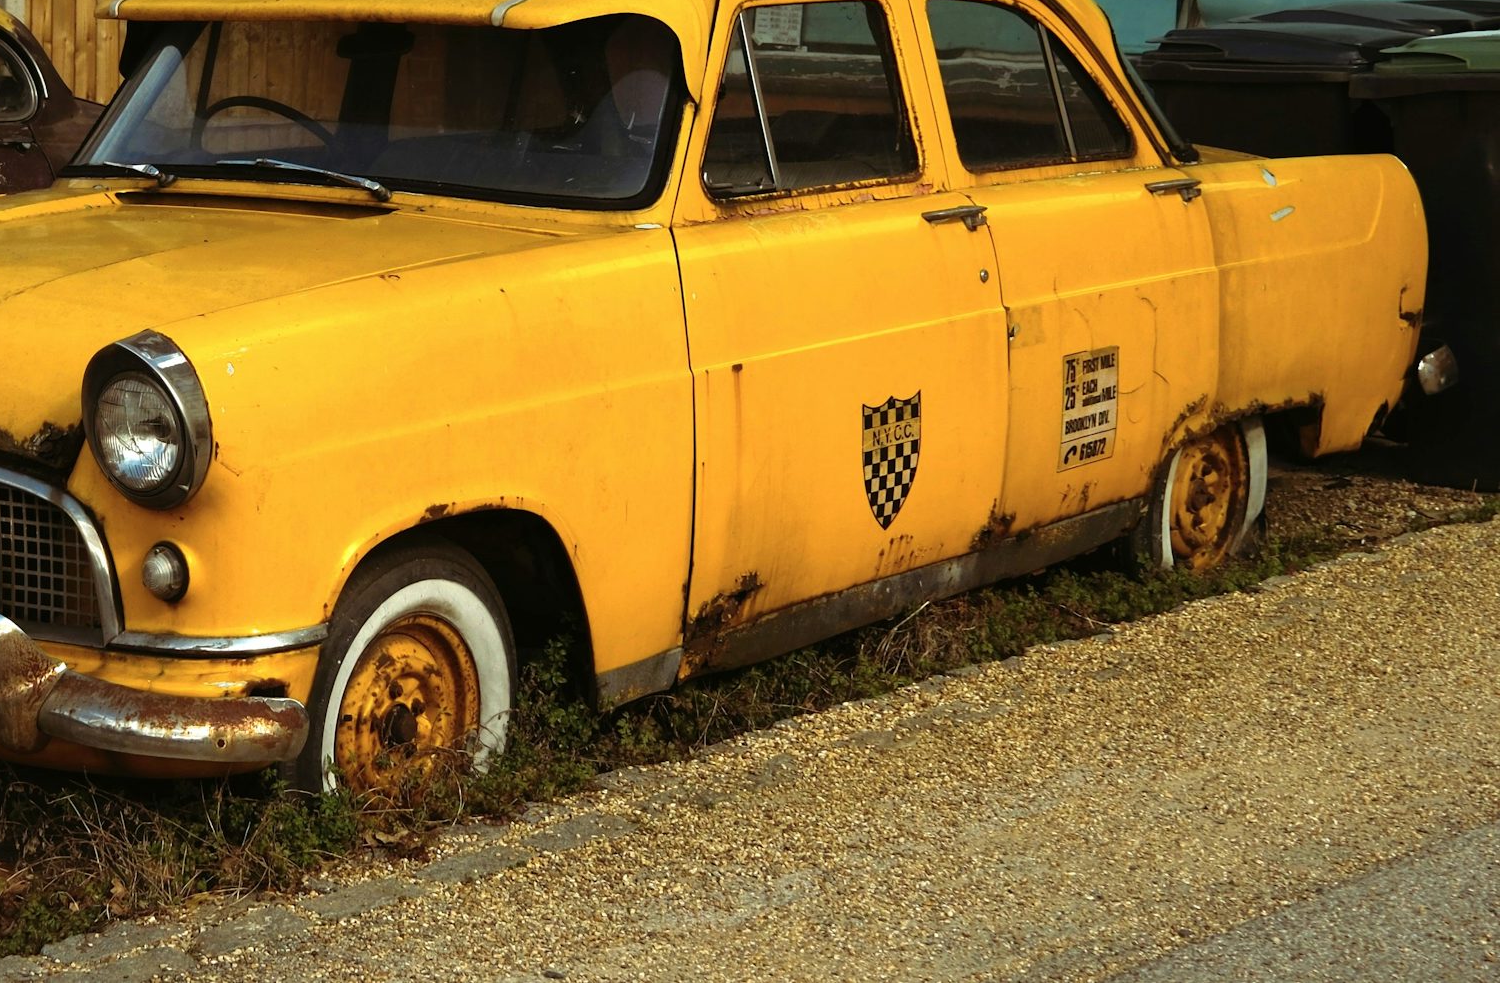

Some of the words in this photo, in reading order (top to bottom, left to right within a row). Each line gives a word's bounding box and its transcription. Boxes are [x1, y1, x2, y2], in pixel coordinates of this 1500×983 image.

[1082, 357, 1099, 376] FIRST
[1100, 353, 1116, 371] MILE
[1082, 378, 1098, 396] EACH
[1101, 385, 1117, 402] MILE
[1064, 412, 1097, 435] BROOKLYN
